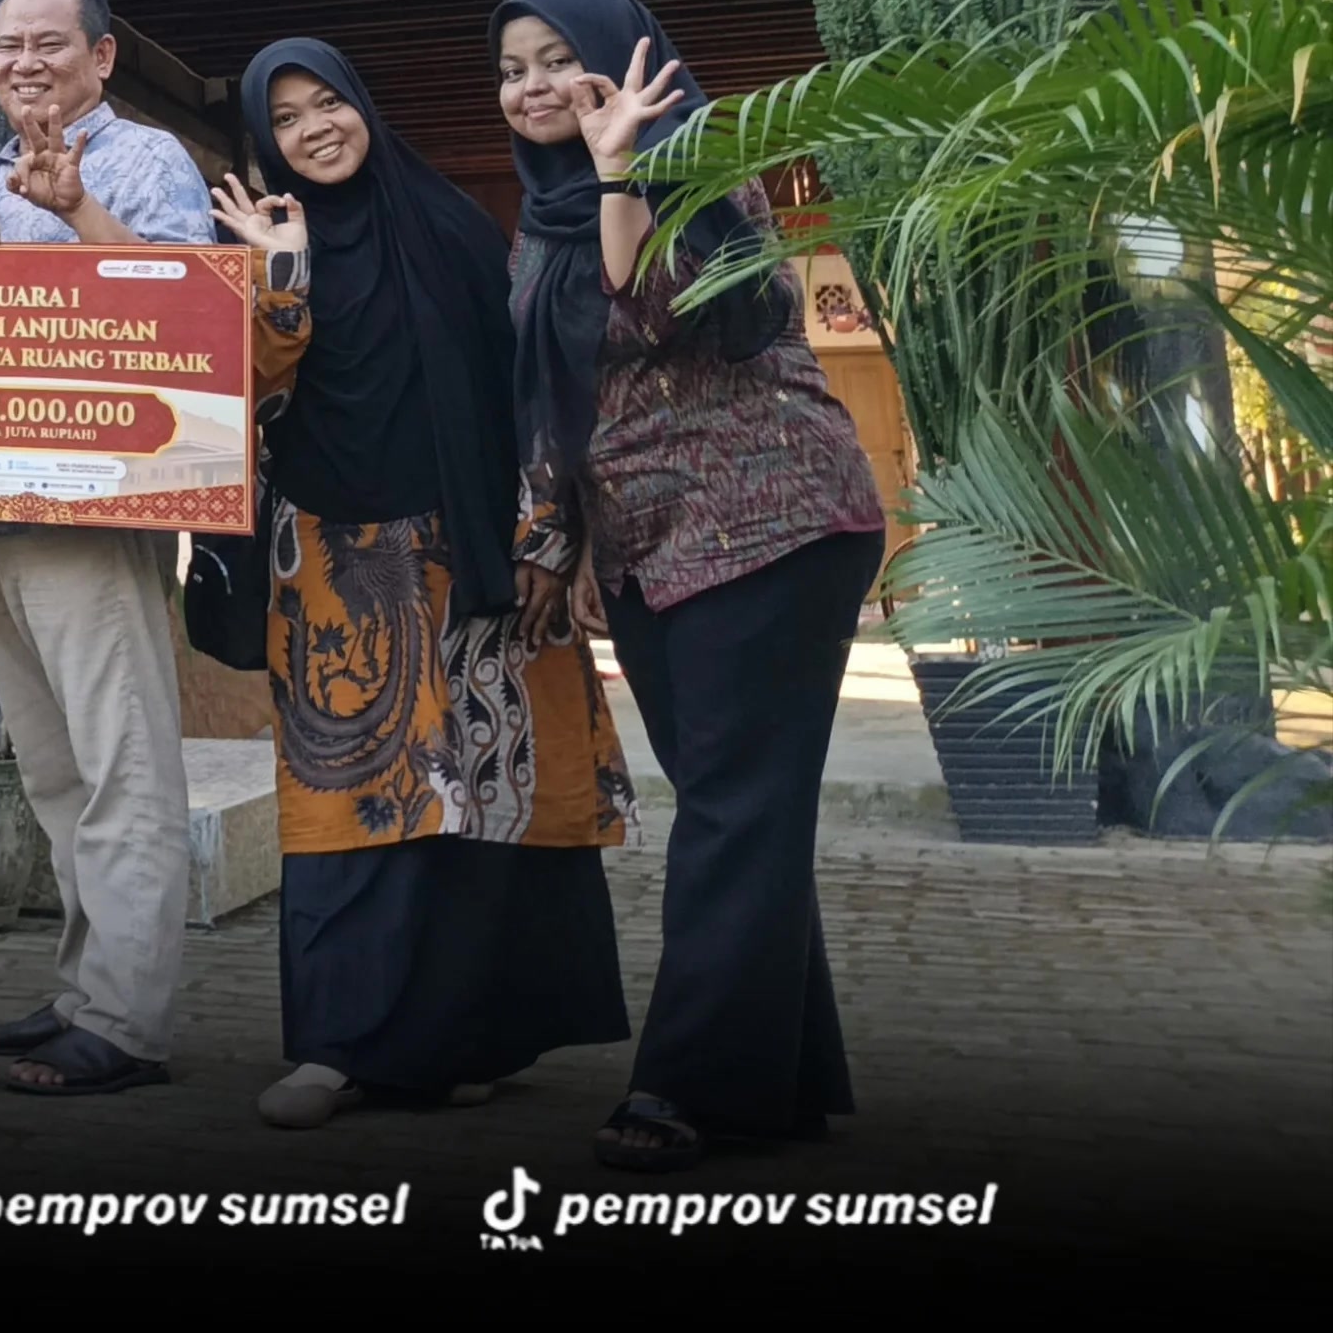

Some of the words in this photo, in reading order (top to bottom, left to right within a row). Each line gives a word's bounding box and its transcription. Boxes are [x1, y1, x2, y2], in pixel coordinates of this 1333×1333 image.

[70, 286, 81, 308] 1
[10, 317, 158, 343] ANJUNGAN
[21, 348, 105, 370] RUANG
[109, 351, 213, 374] TERBAIK
[4, 426, 37, 439] JUTA
[40, 427, 97, 441] RUPIAH)
